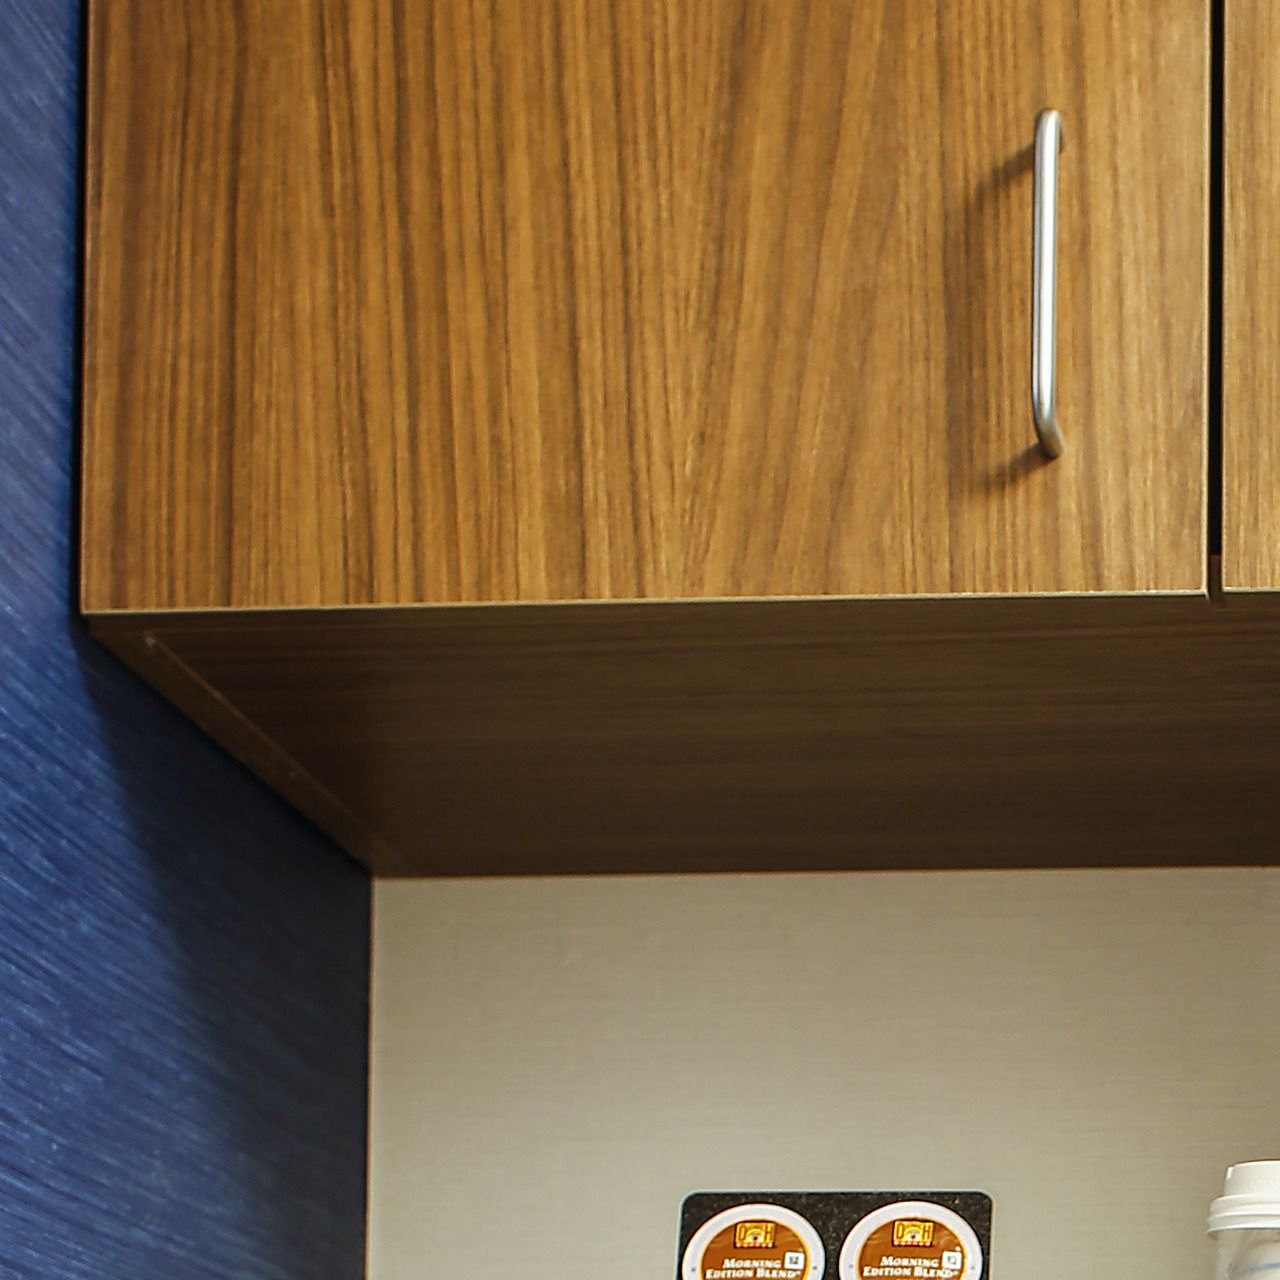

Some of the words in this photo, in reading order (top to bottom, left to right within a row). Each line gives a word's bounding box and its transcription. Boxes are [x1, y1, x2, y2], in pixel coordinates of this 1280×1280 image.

[722, 1258, 782, 1269] MORNING
[880, 1256, 940, 1268] MORNING
[705, 1269, 753, 1280] EDITION
[863, 1266, 912, 1277] EDITION
